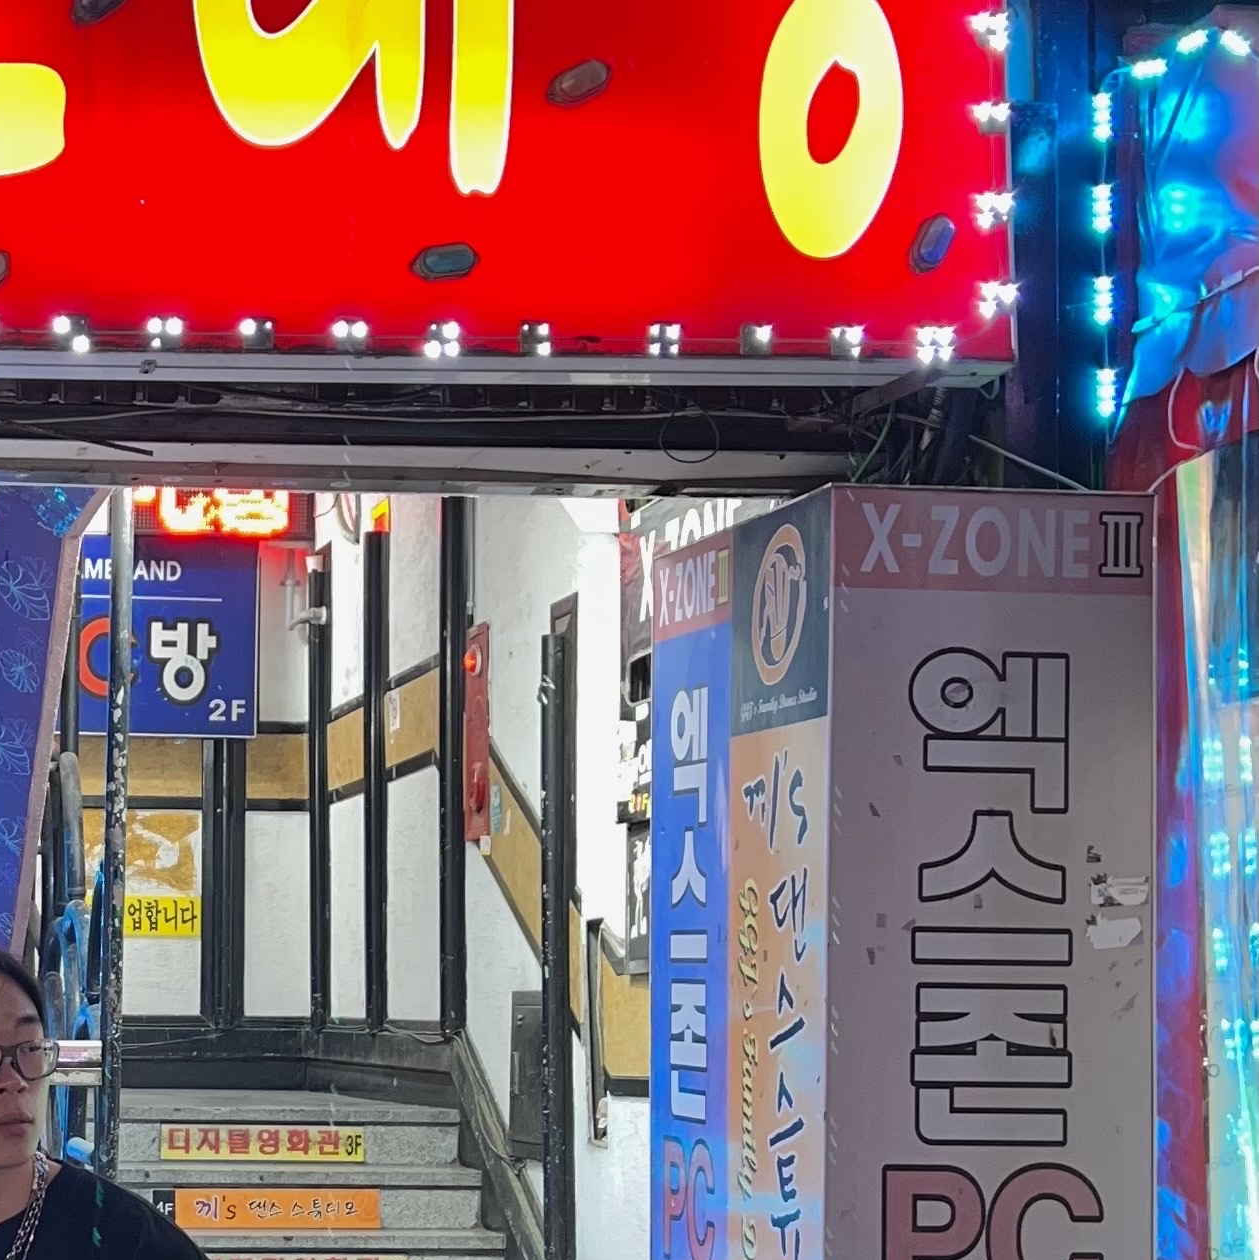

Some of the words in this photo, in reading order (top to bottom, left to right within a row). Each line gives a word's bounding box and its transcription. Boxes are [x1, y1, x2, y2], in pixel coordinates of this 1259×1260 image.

[860, 502, 1089, 580] X-ZONE
[659, 550, 715, 628] X-ZONE
[208, 699, 246, 722] 2F
[345, 1135, 362, 1156] 3F
